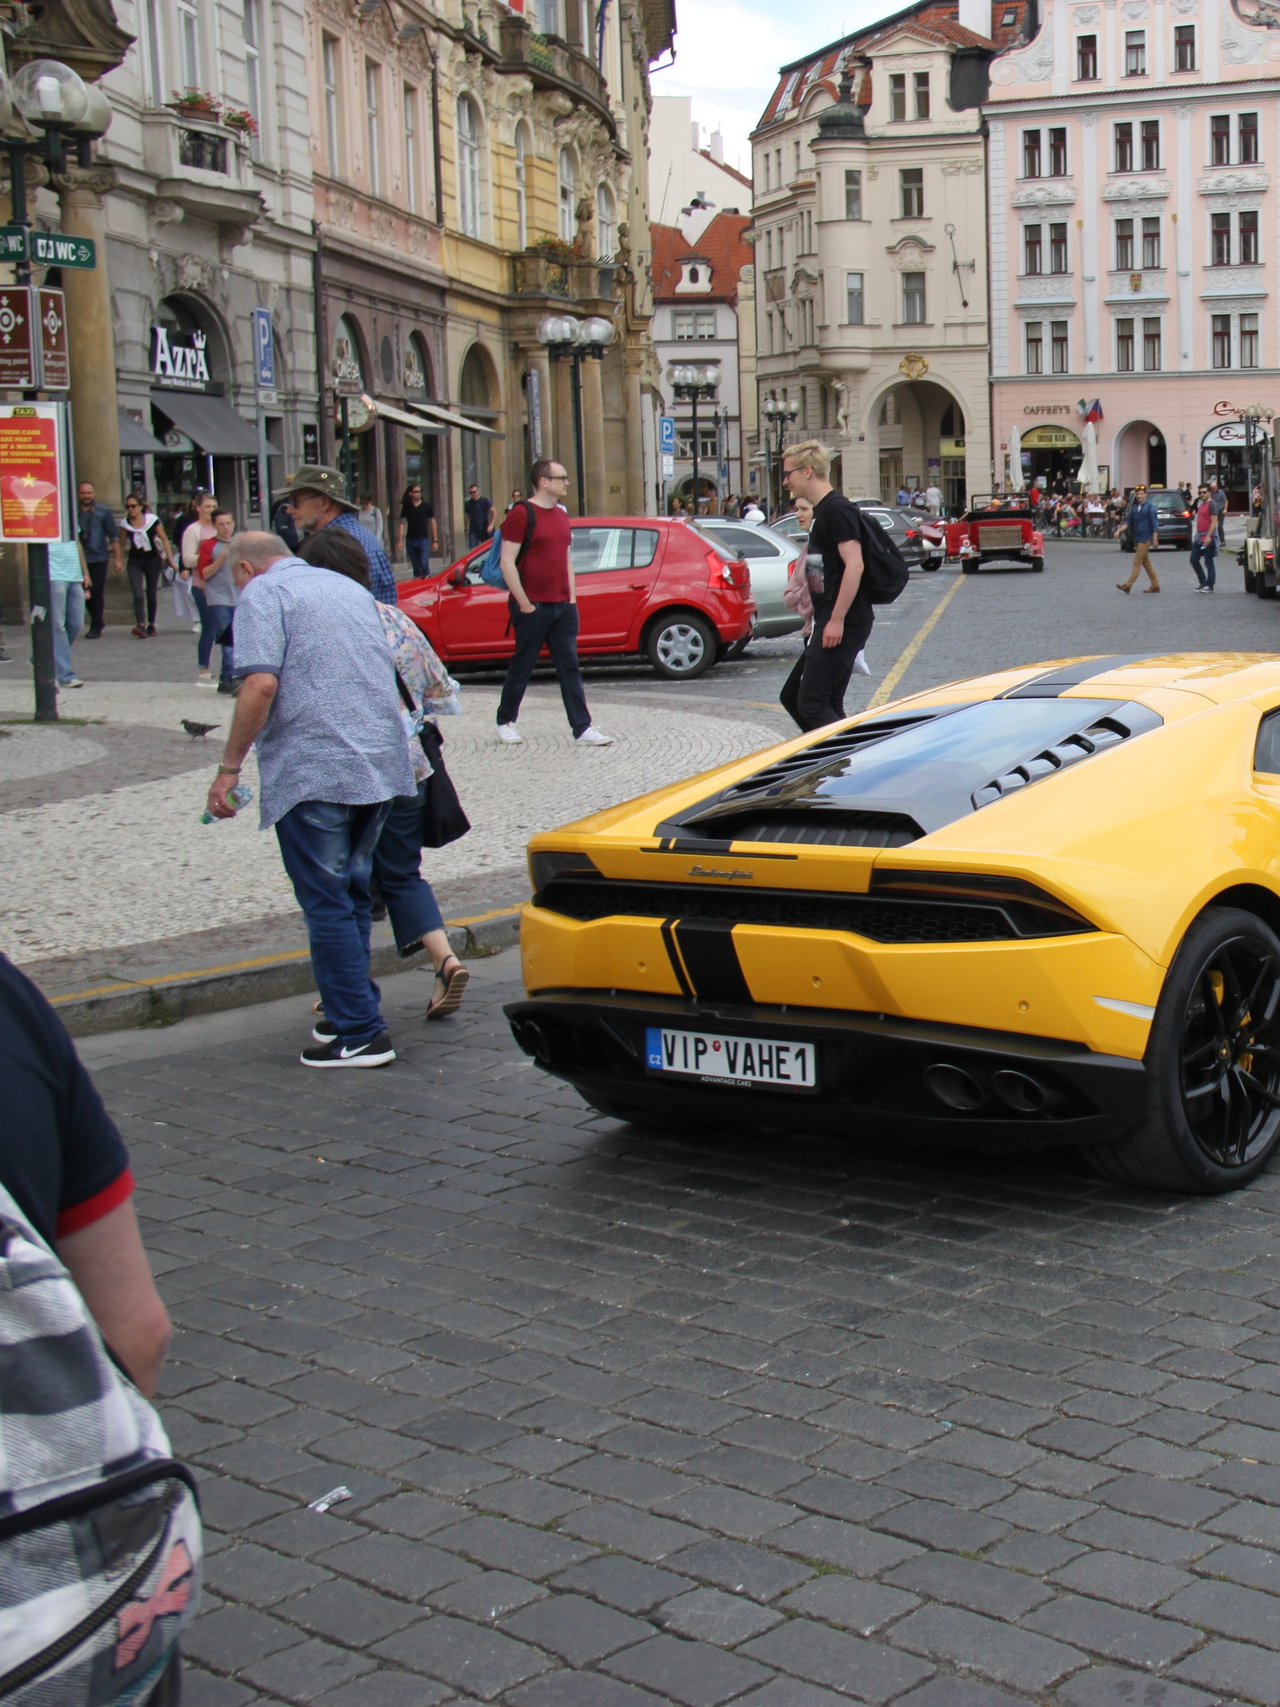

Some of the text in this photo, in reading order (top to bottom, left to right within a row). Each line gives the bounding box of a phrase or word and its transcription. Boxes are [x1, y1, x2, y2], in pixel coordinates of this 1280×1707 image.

[7, 235, 24, 252] WC
[55, 241, 76, 261] WC
[258, 317, 270, 361] P
[15, 408, 36, 416] TAXI
[1023, 405, 1071, 415] CAFFREY'S
[663, 421, 671, 442] P
[650, 1054, 662, 1065] CZ
[663, 1033, 807, 1082] VIP VAHE1
[701, 1076, 752, 1087] ADVANTAGE CARS
